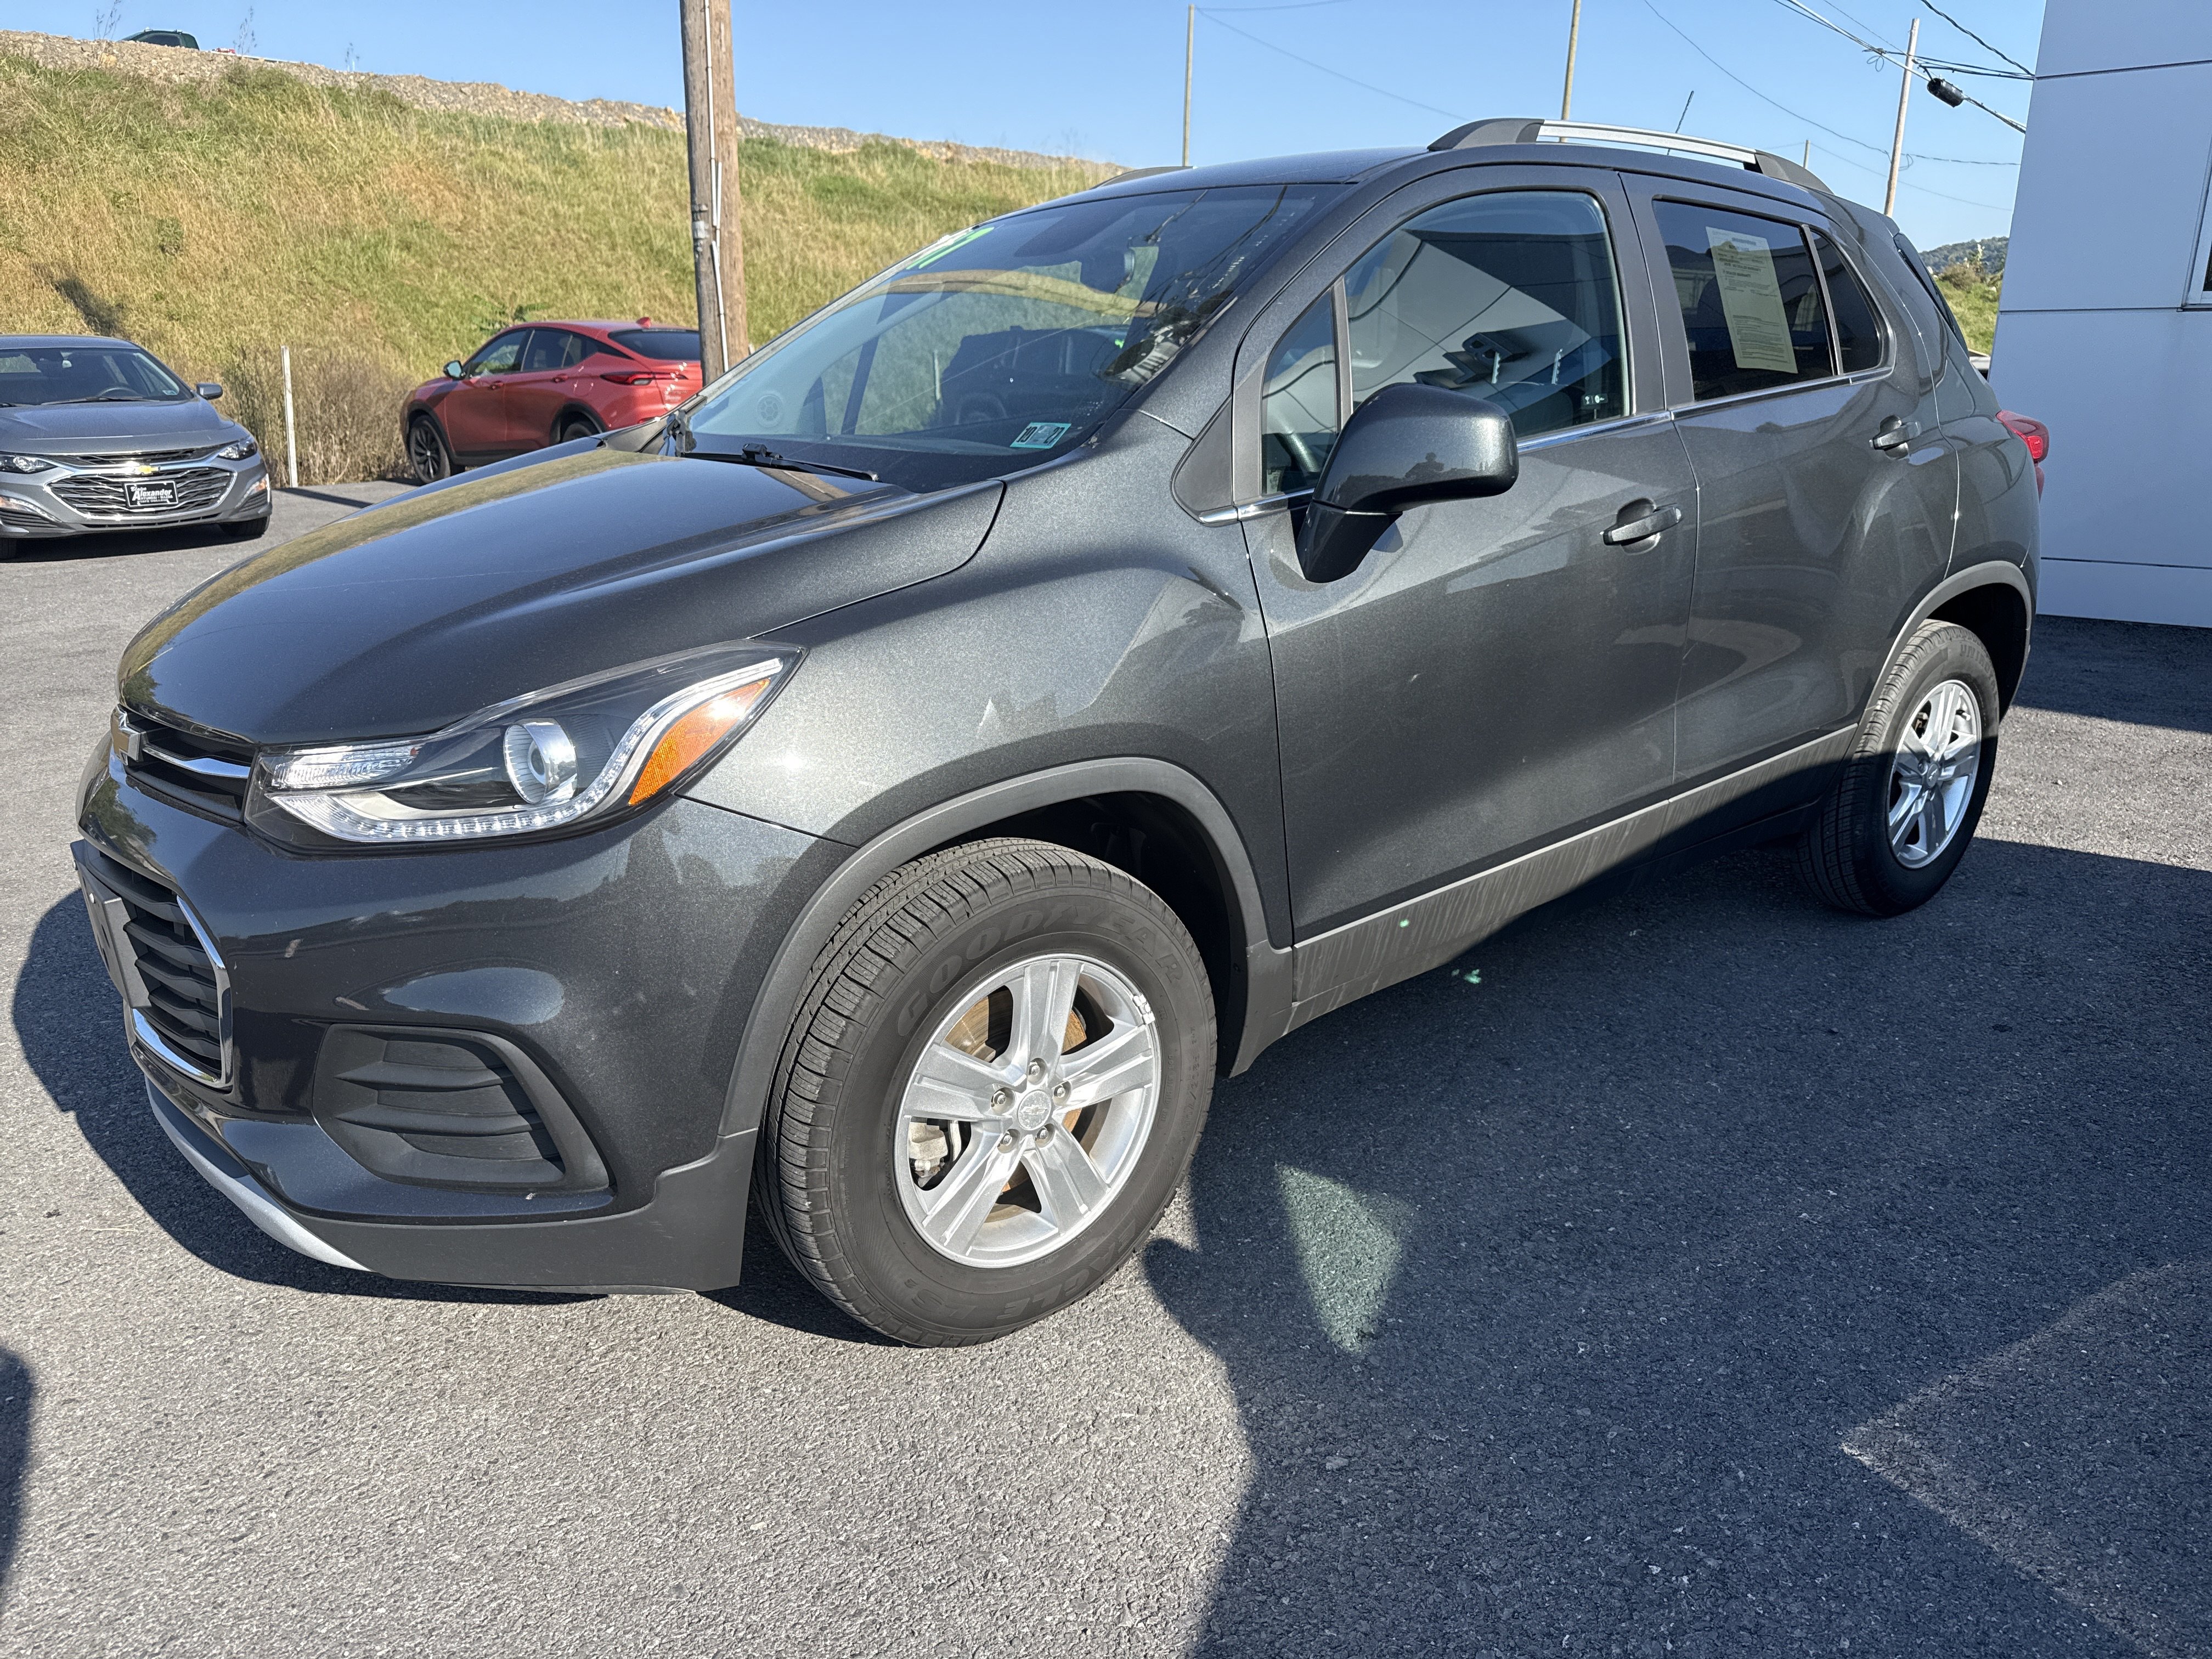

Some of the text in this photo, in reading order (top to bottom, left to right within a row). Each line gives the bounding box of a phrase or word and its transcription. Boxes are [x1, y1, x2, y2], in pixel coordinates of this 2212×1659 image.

[1043, 427, 1065, 444] 27
[132, 488, 172, 501] Alexander
[897, 904, 1184, 1037] GOODYEAR
[996, 1219, 1137, 1320] EAGLE
